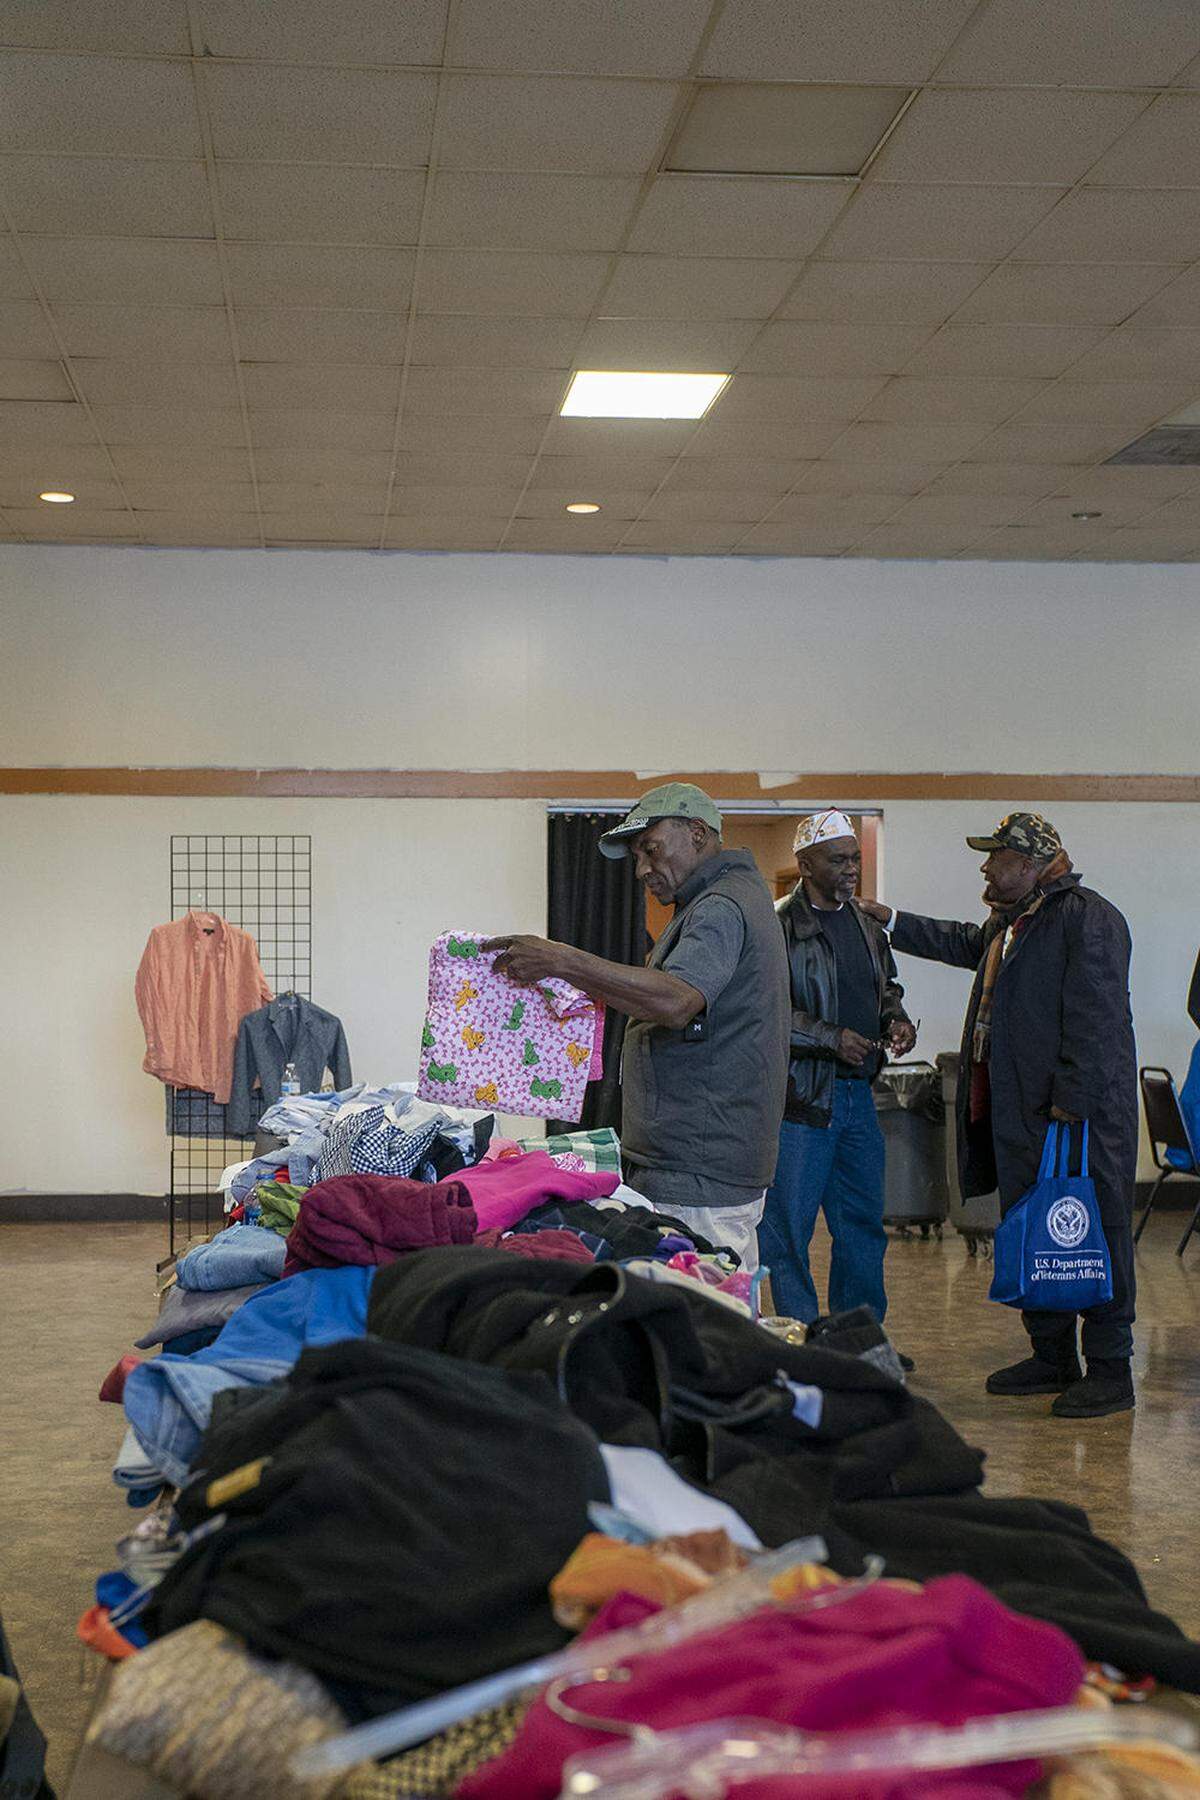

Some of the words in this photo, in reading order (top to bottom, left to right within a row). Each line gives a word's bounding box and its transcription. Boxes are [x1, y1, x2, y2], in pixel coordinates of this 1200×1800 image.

[1034, 1258, 1050, 1269] U.S.
[1052, 1258, 1104, 1271] Department
[1031, 1270, 1041, 1281] of
[1040, 1270, 1076, 1280] Veterans
[1077, 1268, 1106, 1280] Affairs
